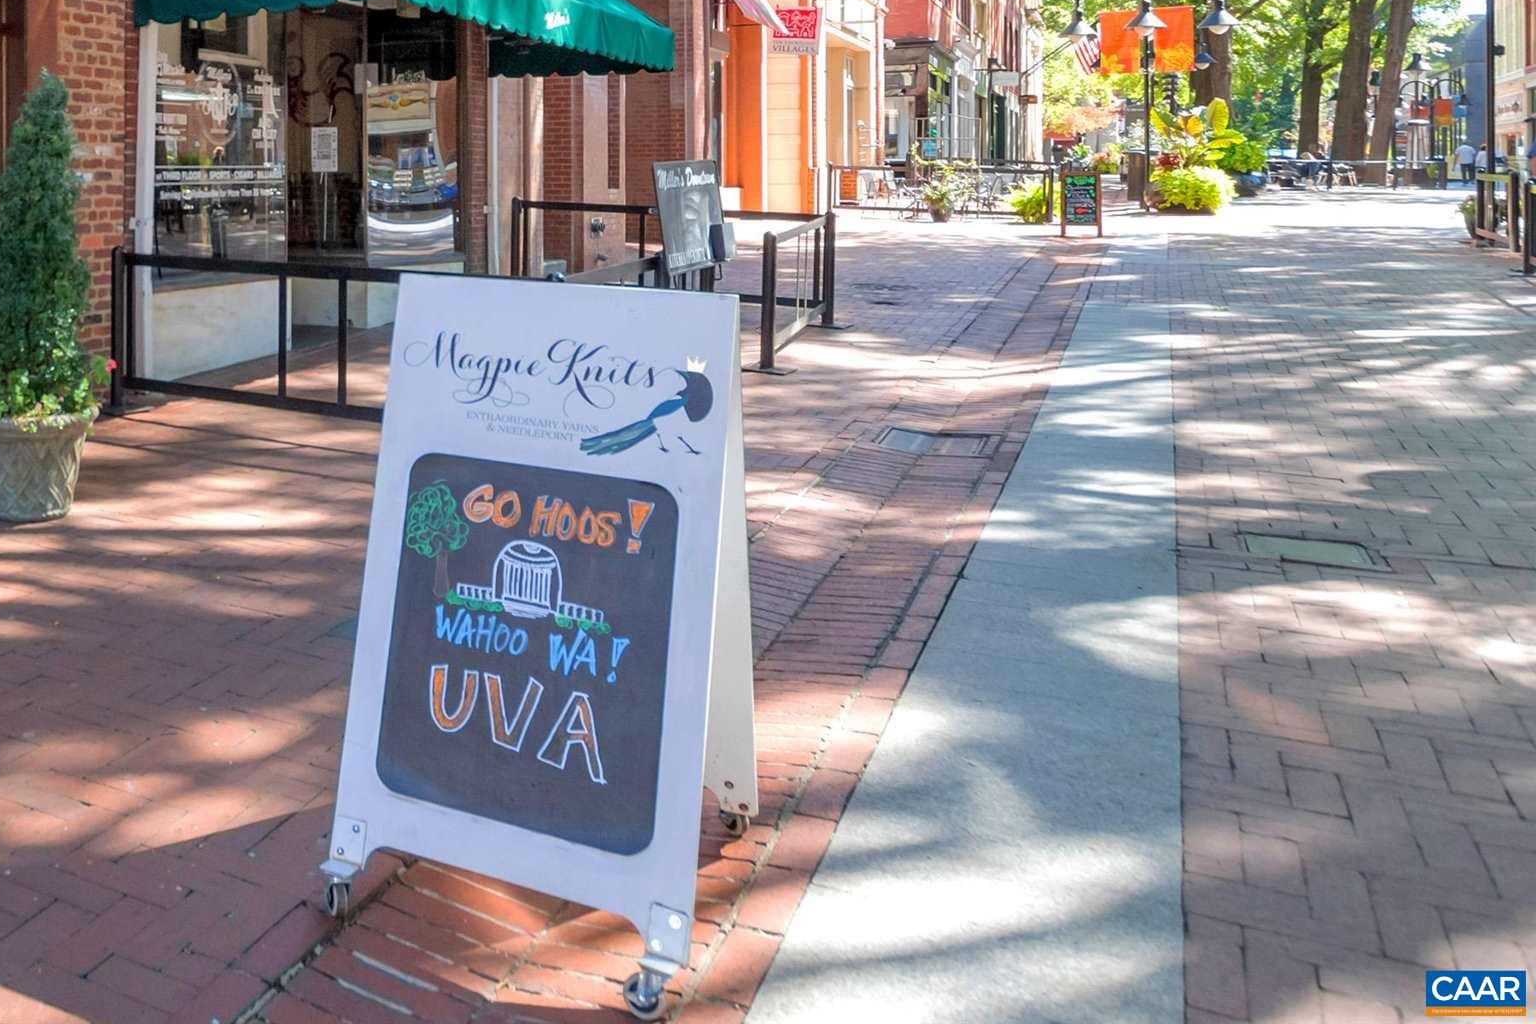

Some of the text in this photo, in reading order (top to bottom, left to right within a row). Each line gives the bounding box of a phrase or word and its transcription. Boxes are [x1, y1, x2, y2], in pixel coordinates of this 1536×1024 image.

[403, 331, 656, 409] Magpie Knits
[462, 483, 523, 528] GO
[435, 603, 529, 656] WAHOO
[429, 664, 608, 785] UVA
